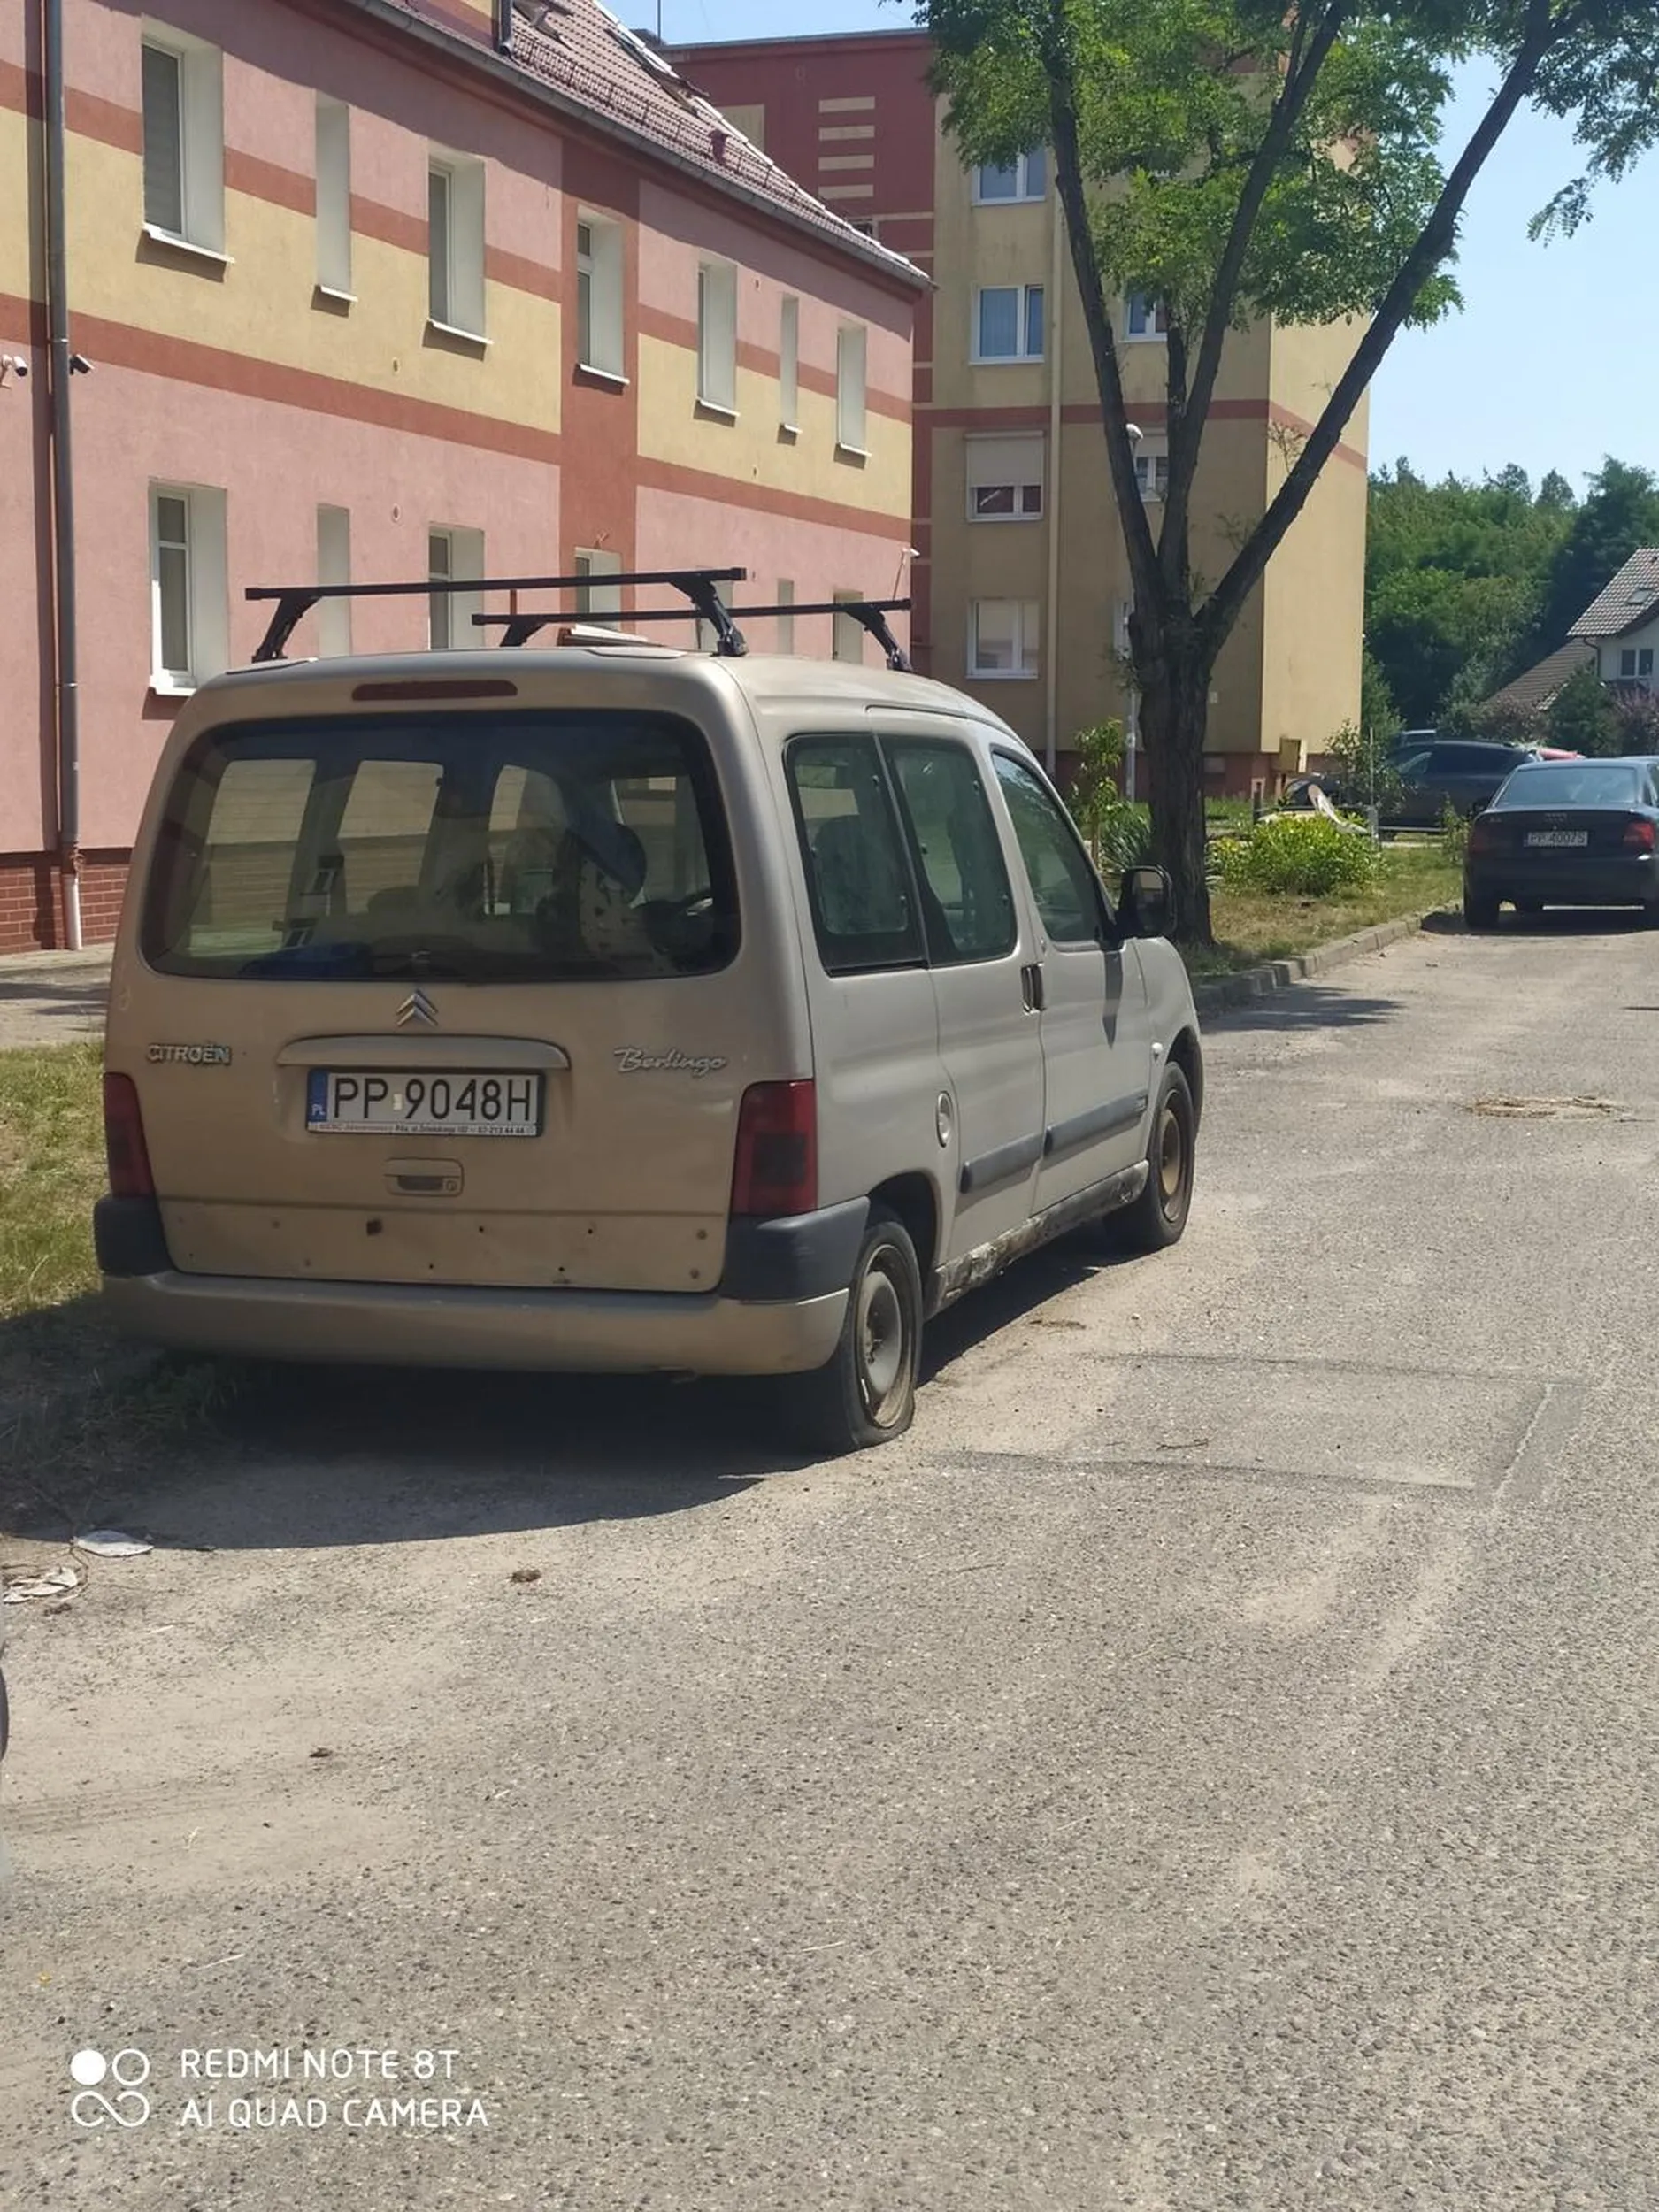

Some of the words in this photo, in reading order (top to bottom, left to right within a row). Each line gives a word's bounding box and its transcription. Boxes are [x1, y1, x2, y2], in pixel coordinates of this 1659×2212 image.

[614, 1047, 727, 1077] Berlingo
[311, 1104, 326, 1116] PL
[334, 1078, 388, 1118] PP
[405, 1079, 531, 1121] 9048H
